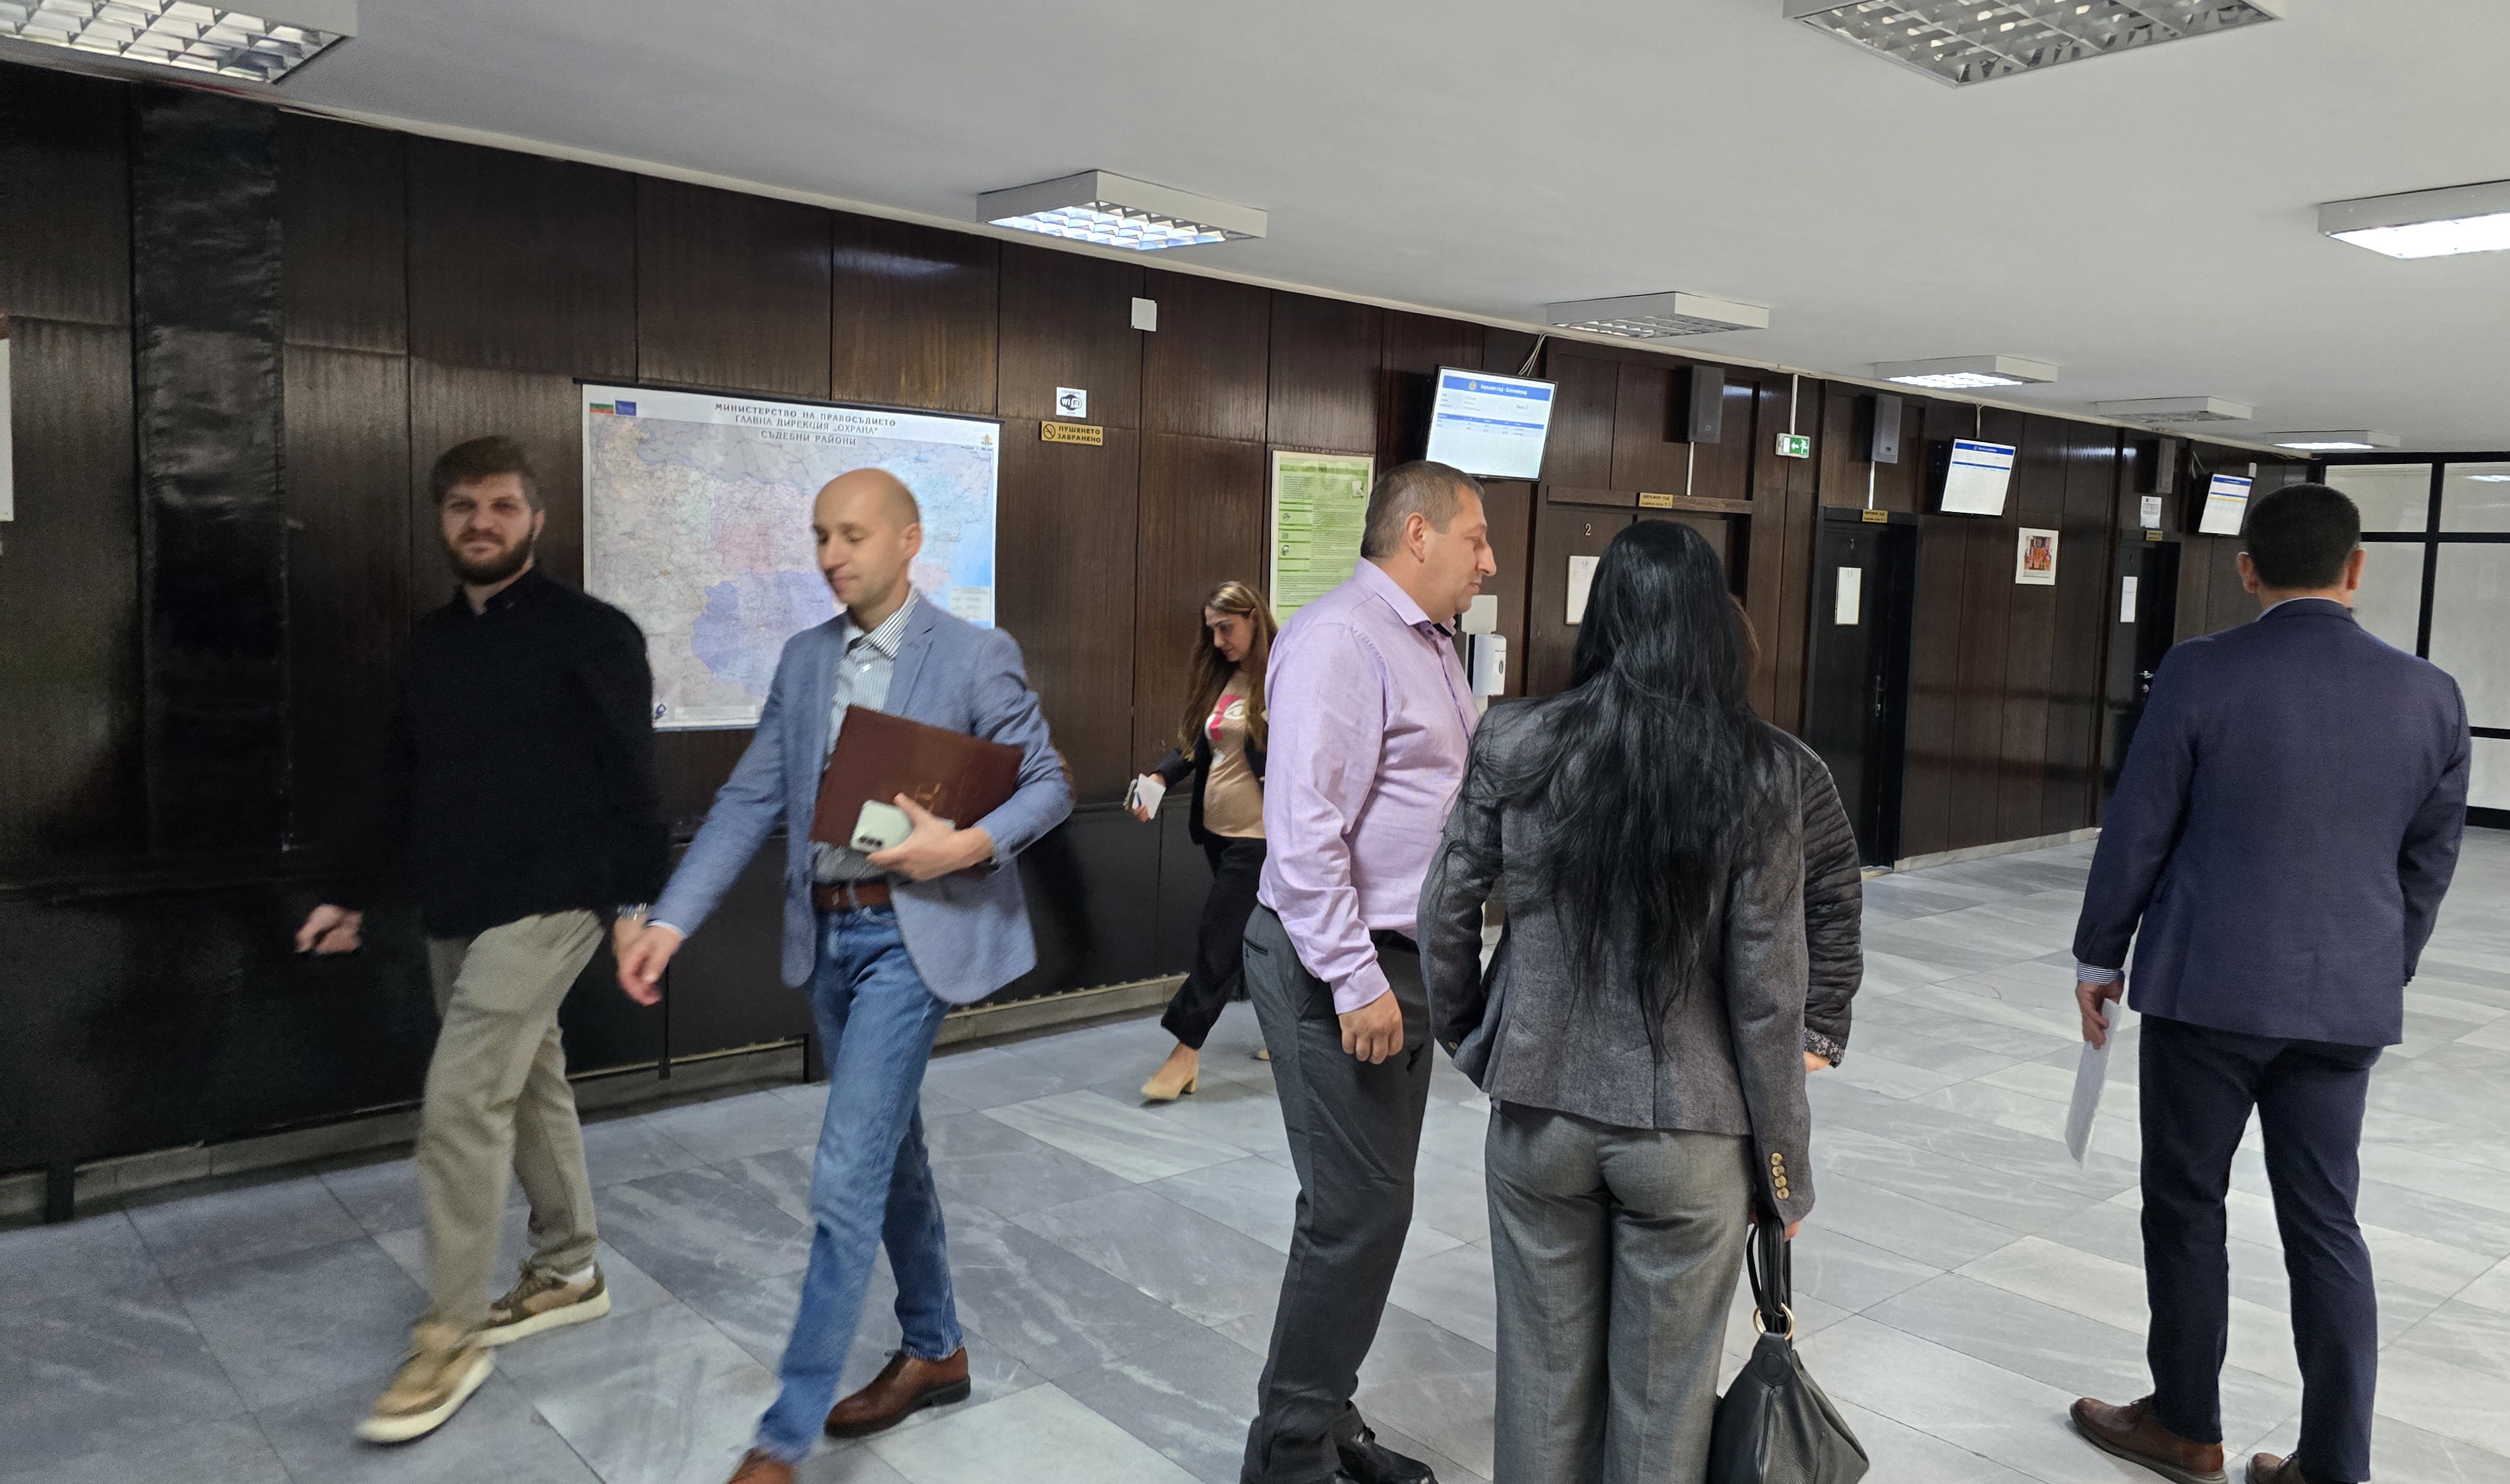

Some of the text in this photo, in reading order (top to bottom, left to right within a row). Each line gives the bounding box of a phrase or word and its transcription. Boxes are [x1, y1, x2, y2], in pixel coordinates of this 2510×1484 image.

[715, 403, 797, 418] МИНИСТЕРСТВО
[821, 413, 896, 427] ПРАВОСЪДИЕТО
[736, 415, 773, 426] ГЛАВНА
[776, 420, 829, 431] ДИРЕКЦИЯ
[761, 430, 856, 445] СЪДЕБНИ РАЙОНИ
[1059, 426, 1100, 435] ПУШЕНЕТО
[1057, 433, 1101, 443] ЗАБРАНЕНО
[1585, 523, 1591, 536] 2
